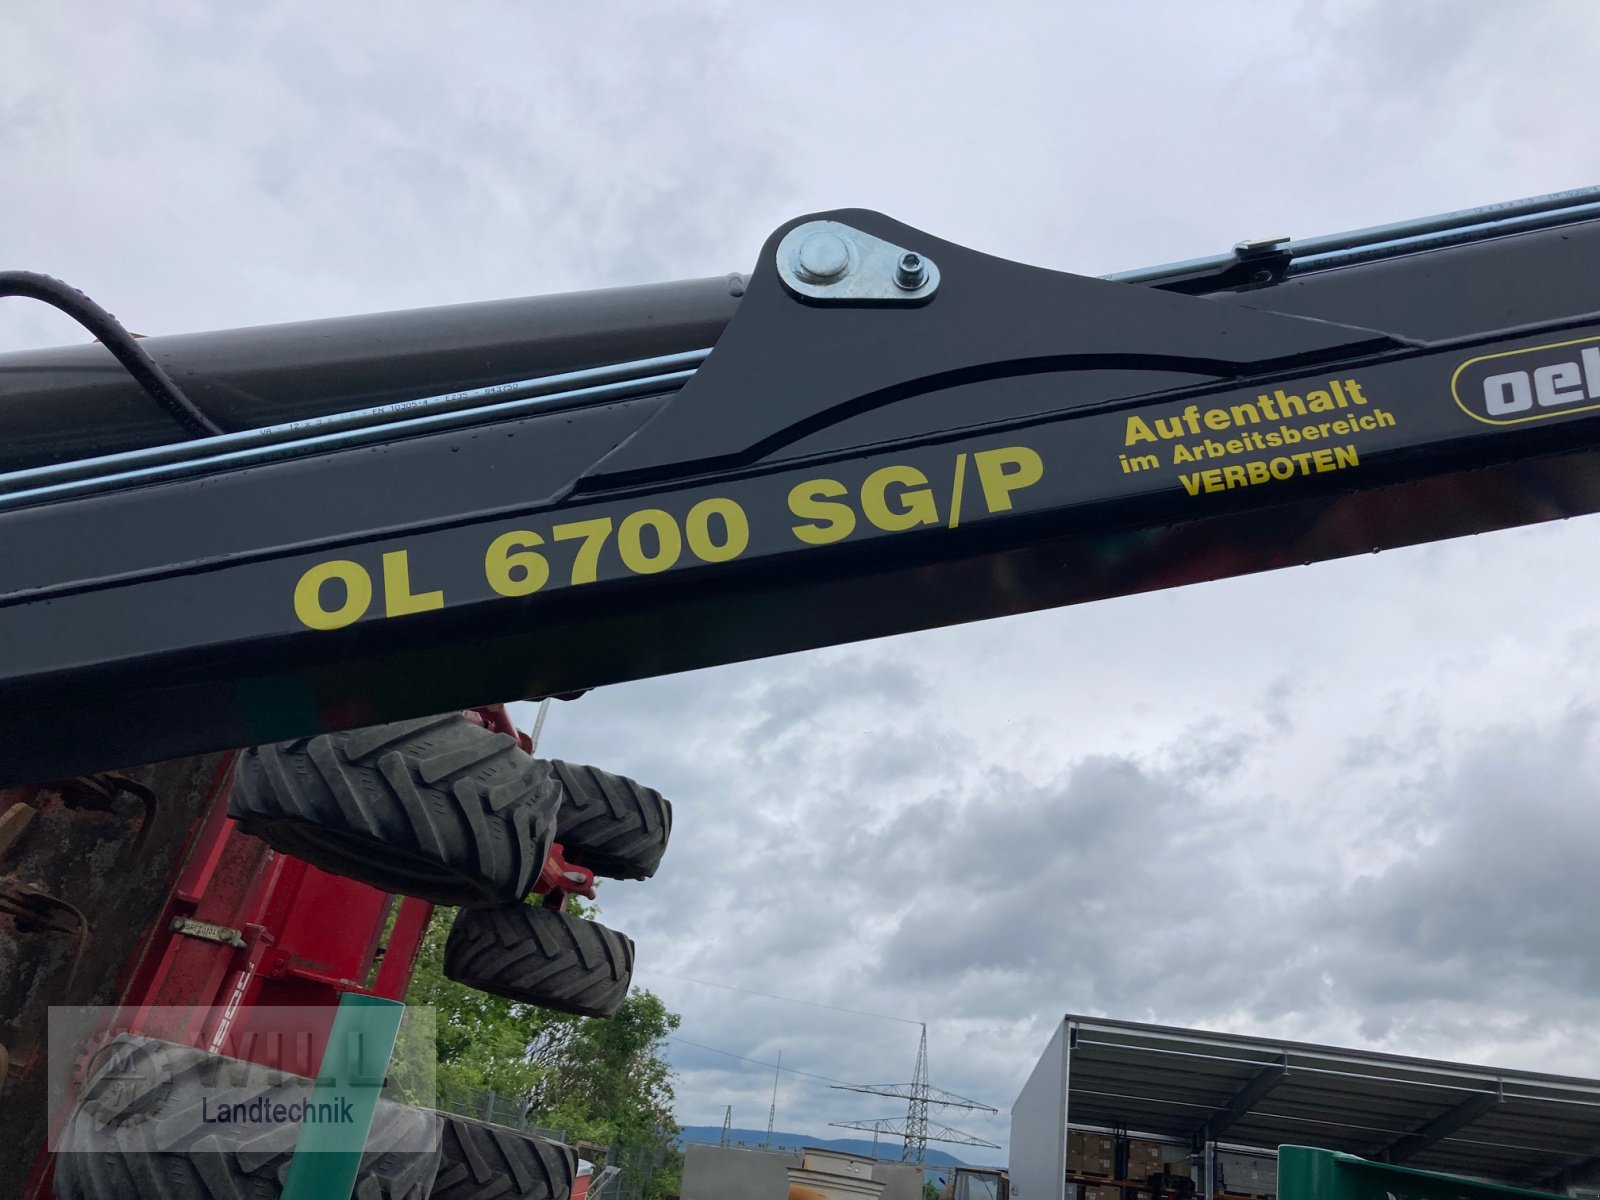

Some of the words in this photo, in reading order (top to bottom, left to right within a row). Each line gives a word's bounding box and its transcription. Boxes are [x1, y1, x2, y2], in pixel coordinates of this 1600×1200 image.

[1120, 454, 1160, 475] im
[1173, 409, 1395, 465] Arbeitsbereich
[1125, 380, 1366, 445] Aufenthalt
[1179, 444, 1361, 496] VERBOTEN
[294, 551, 445, 631] OL
[485, 498, 749, 597] 6700
[788, 447, 1043, 544] SG/P
